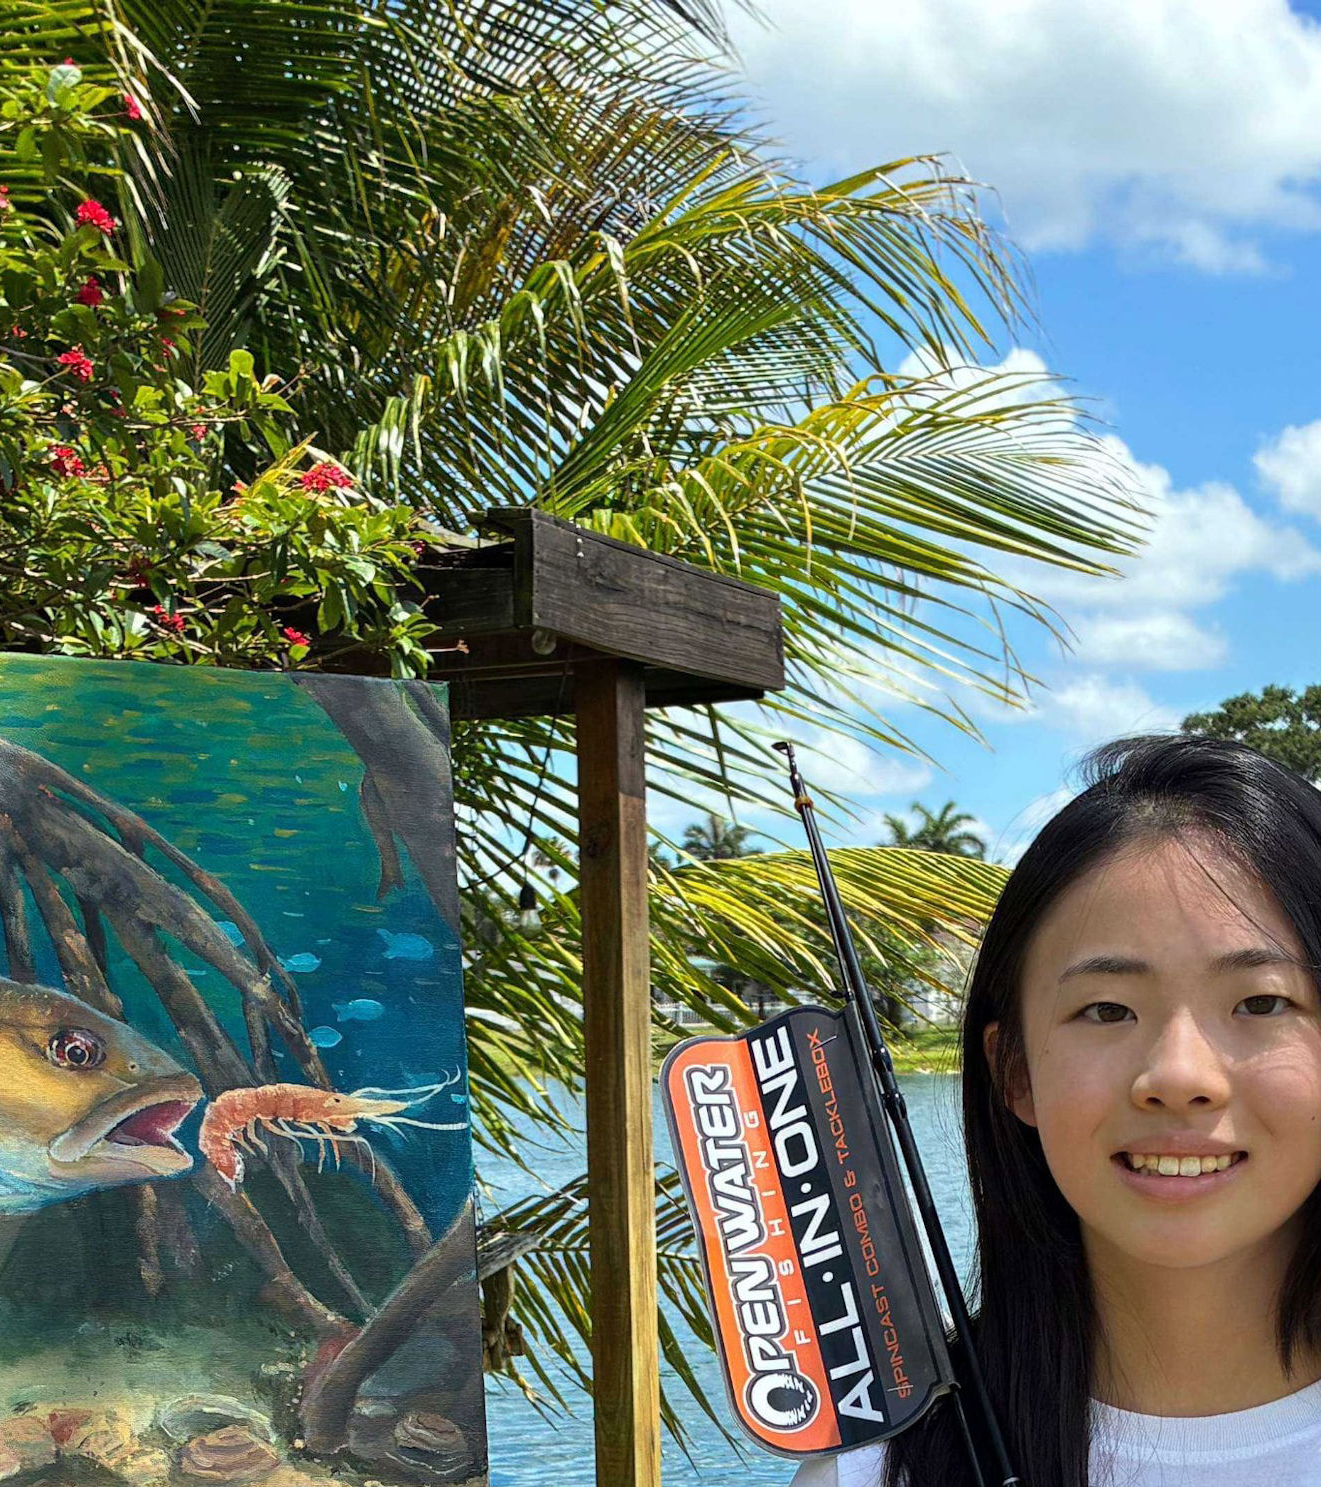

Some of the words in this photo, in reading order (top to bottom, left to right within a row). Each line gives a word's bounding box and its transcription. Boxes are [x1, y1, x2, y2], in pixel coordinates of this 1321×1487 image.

[744, 1110, 812, 1346] FISHING
[843, 1169, 857, 1188] &
[848, 1193, 880, 1277] COMBO
[871, 1284, 912, 1399] SPINCAST
